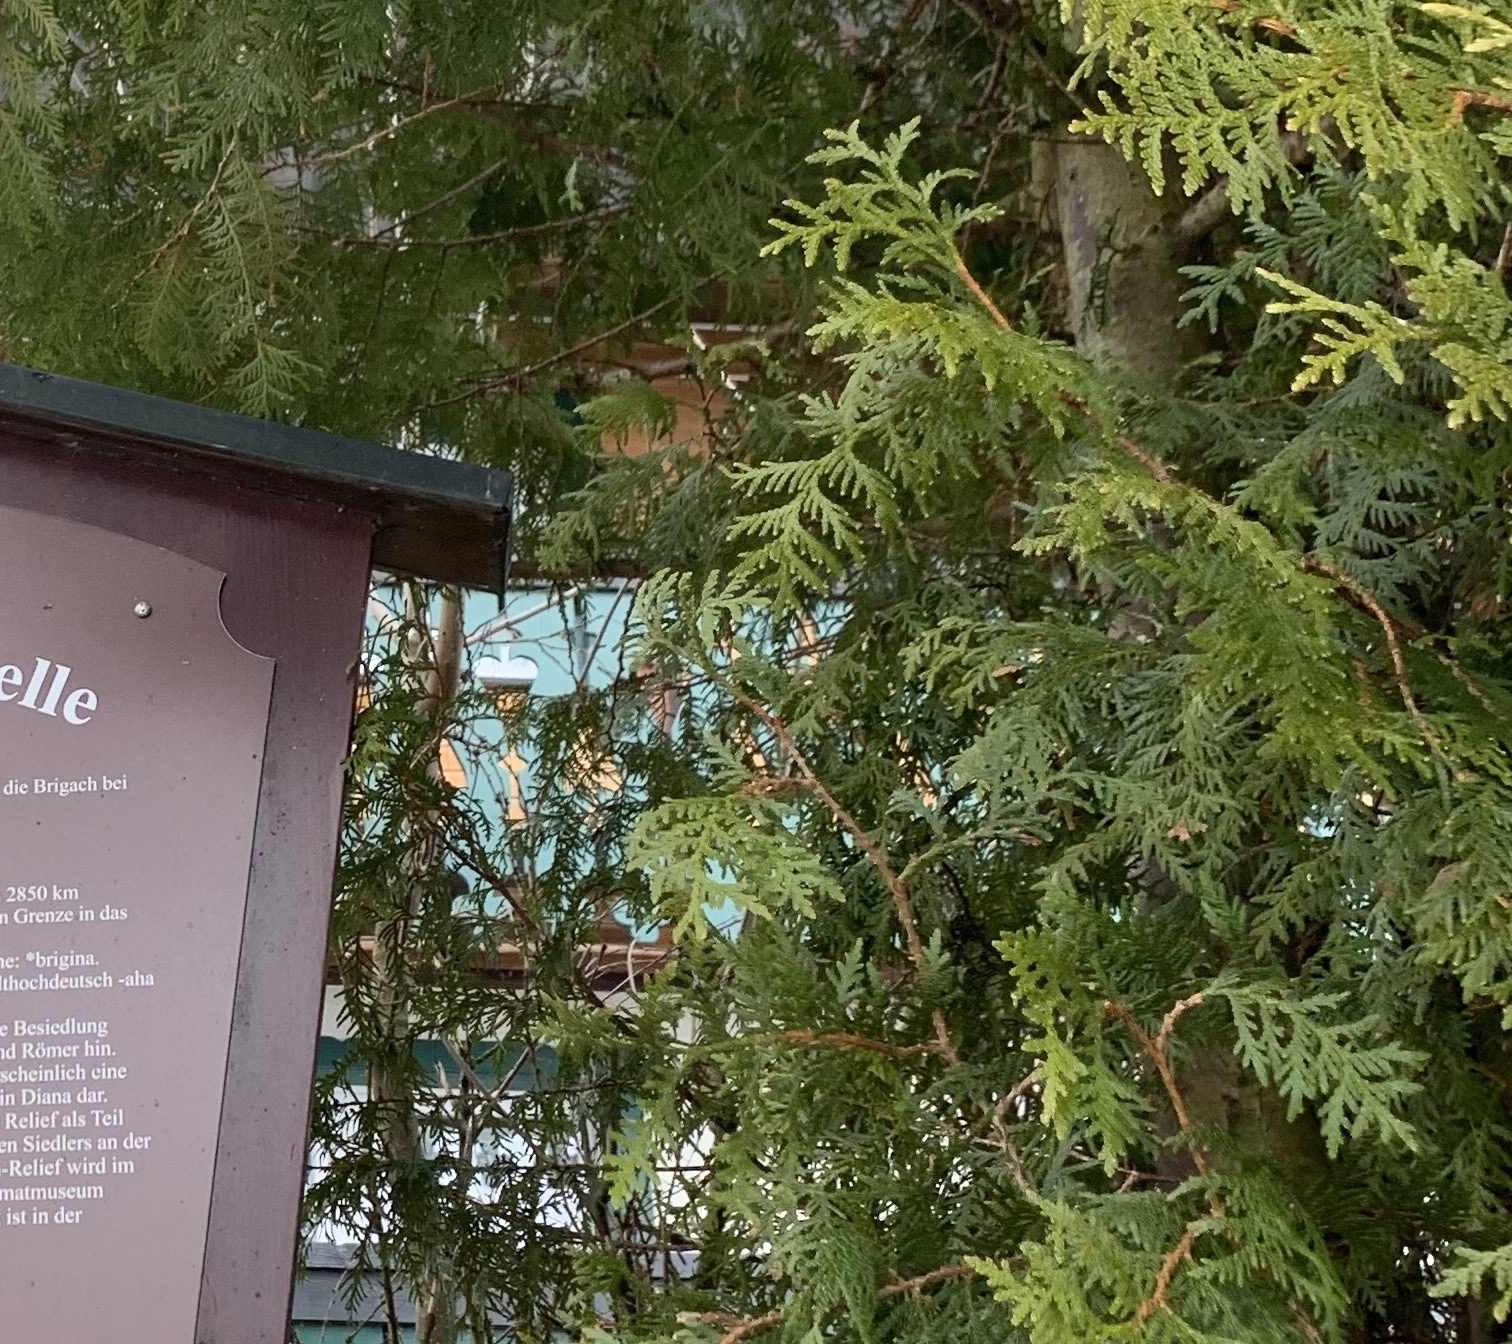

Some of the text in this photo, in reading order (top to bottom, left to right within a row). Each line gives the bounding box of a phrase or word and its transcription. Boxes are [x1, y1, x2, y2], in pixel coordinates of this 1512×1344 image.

[3, 778, 29, 795] die
[34, 775, 97, 797] Brigach
[102, 773, 127, 791] bei
[6, 884, 48, 903] 2850
[53, 883, 79, 901] km
[14, 1017, 108, 1038] Besiedlung
[22, 1041, 80, 1059] Römer
[85, 1038, 116, 1057] hin.
[91, 1061, 127, 1080] eine
[21, 1087, 72, 1106] Diana
[76, 1086, 108, 1104] dar.
[5, 1110, 57, 1129] Relief
[62, 1109, 86, 1128] als
[94, 1107, 123, 1127] Teil
[23, 1133, 93, 1153] Siedlers
[97, 1136, 118, 1150] an
[123, 1131, 152, 1150] der
[66, 1155, 106, 1175] wird
[112, 1155, 134, 1174] im
[6, 1209, 26, 1225] ist
[32, 1206, 49, 1225] in
[54, 1206, 83, 1224] der
